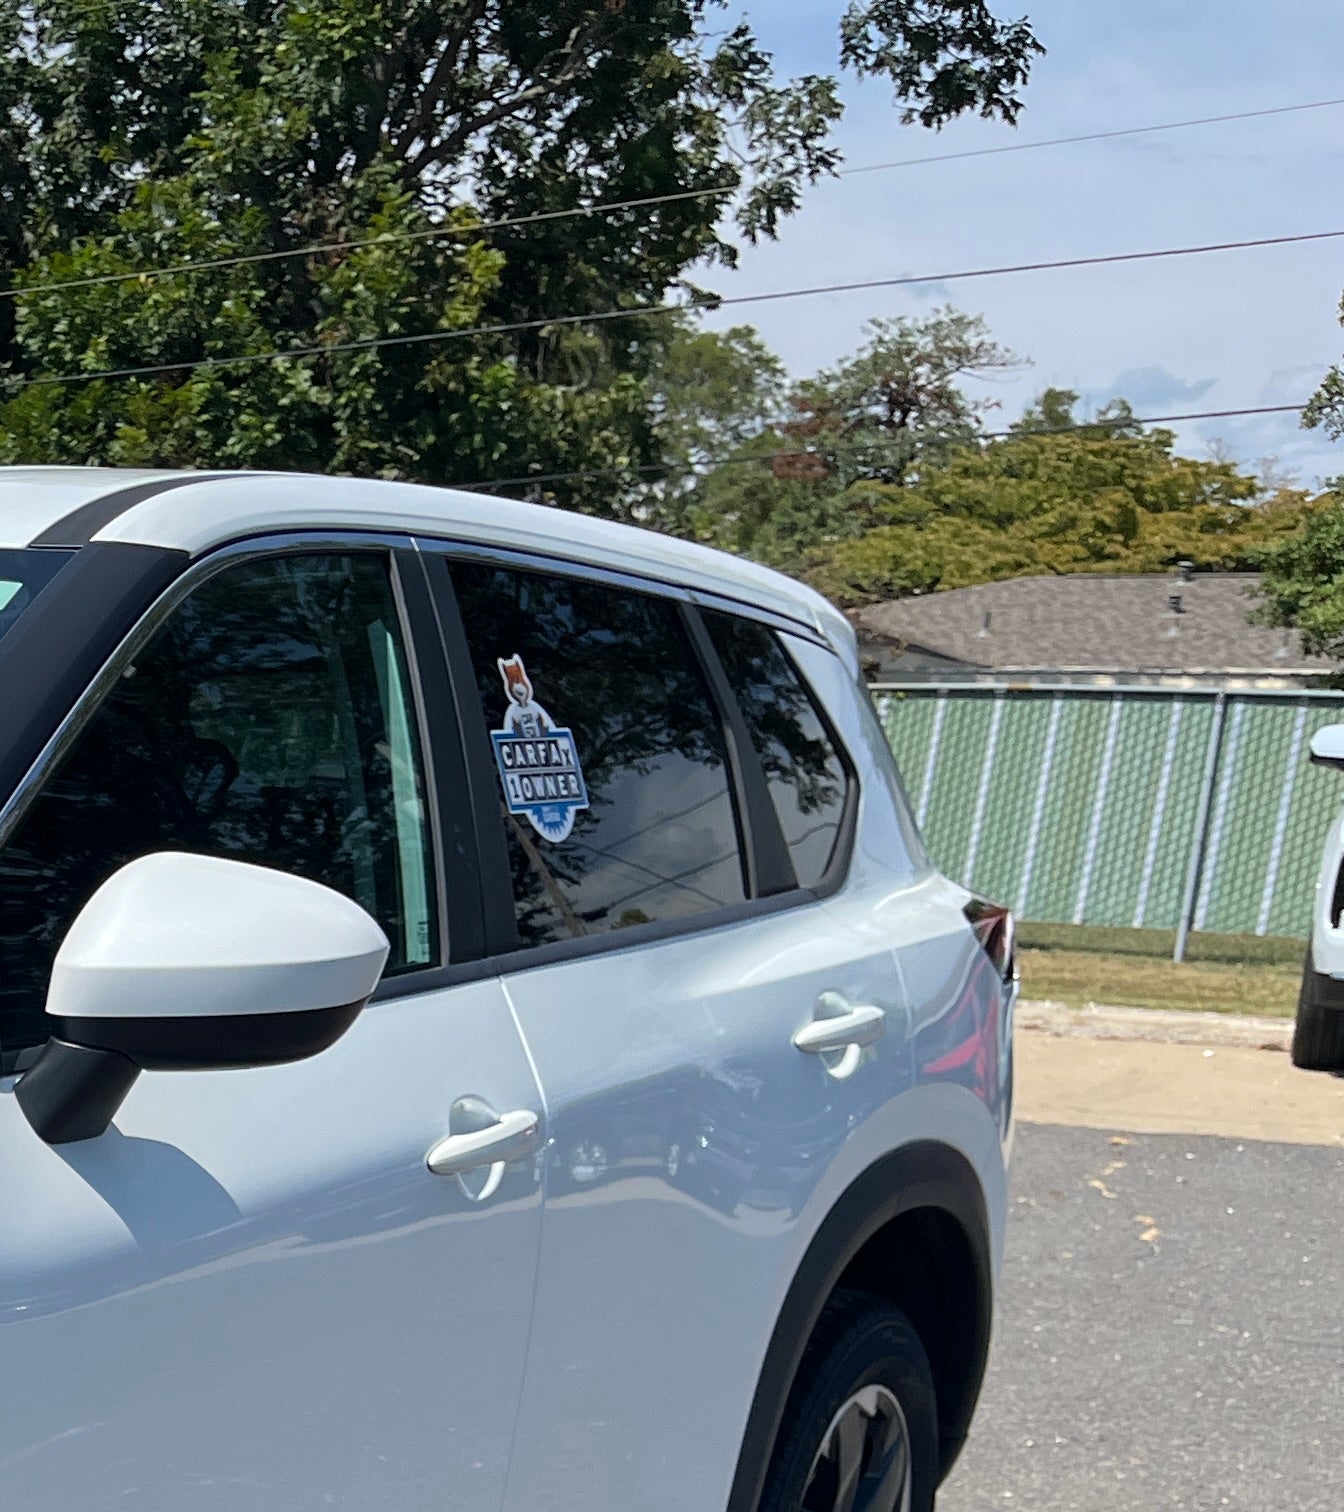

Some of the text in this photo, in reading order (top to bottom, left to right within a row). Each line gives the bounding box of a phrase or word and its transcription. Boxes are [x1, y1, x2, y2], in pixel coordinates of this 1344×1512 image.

[502, 743, 574, 767] CARFAX
[510, 774, 580, 799] 1 OWNER
